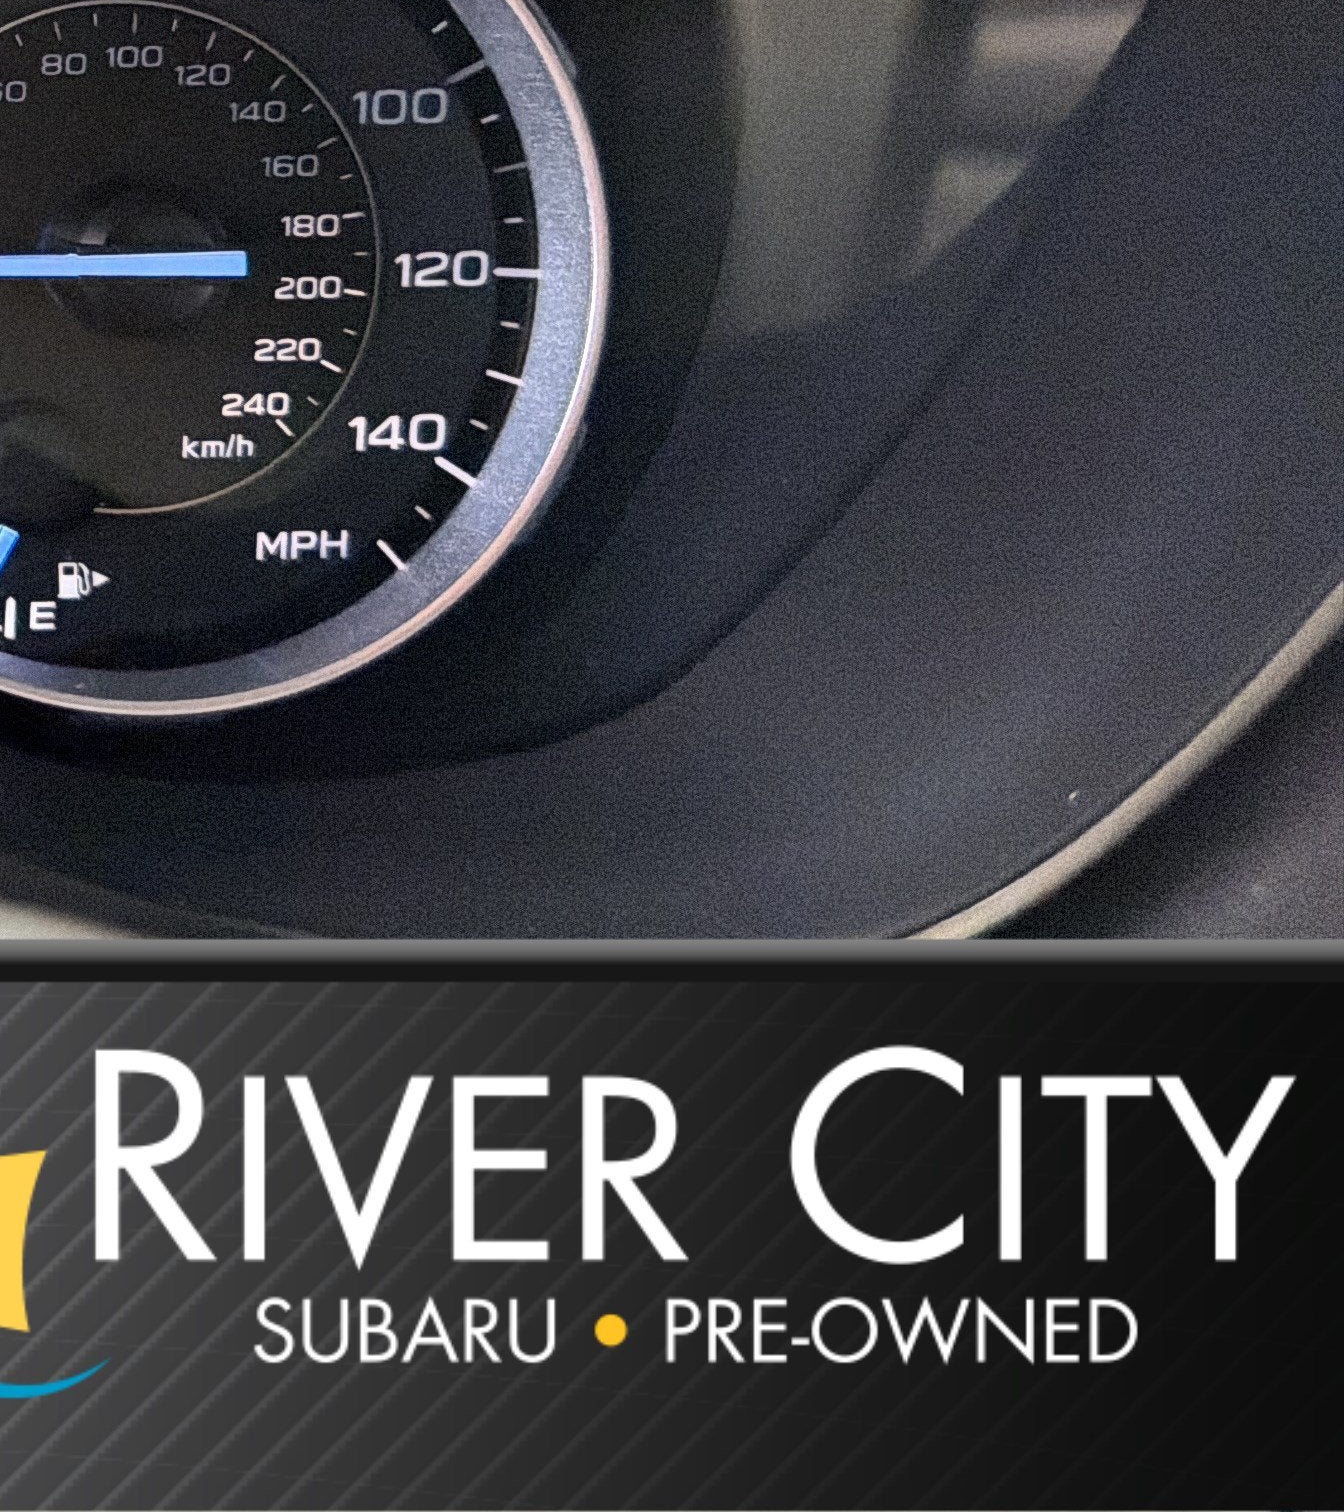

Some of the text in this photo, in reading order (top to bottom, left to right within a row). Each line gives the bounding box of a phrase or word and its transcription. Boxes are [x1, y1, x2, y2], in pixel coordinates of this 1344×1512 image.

[41, 53, 87, 76] 80
[107, 45, 163, 68] 100
[176, 63, 231, 86] 120
[230, 100, 286, 123] 140
[354, 88, 448, 125] 100
[262, 154, 319, 177] 160
[282, 214, 339, 237] 180
[395, 250, 489, 287] 120
[275, 276, 341, 300] 200
[255, 338, 321, 362] 220
[221, 391, 290, 417] 240
[349, 414, 446, 451] 140
[182, 434, 254, 458] km/h
[256, 530, 349, 560] MPH
[30, 601, 55, 630] E
